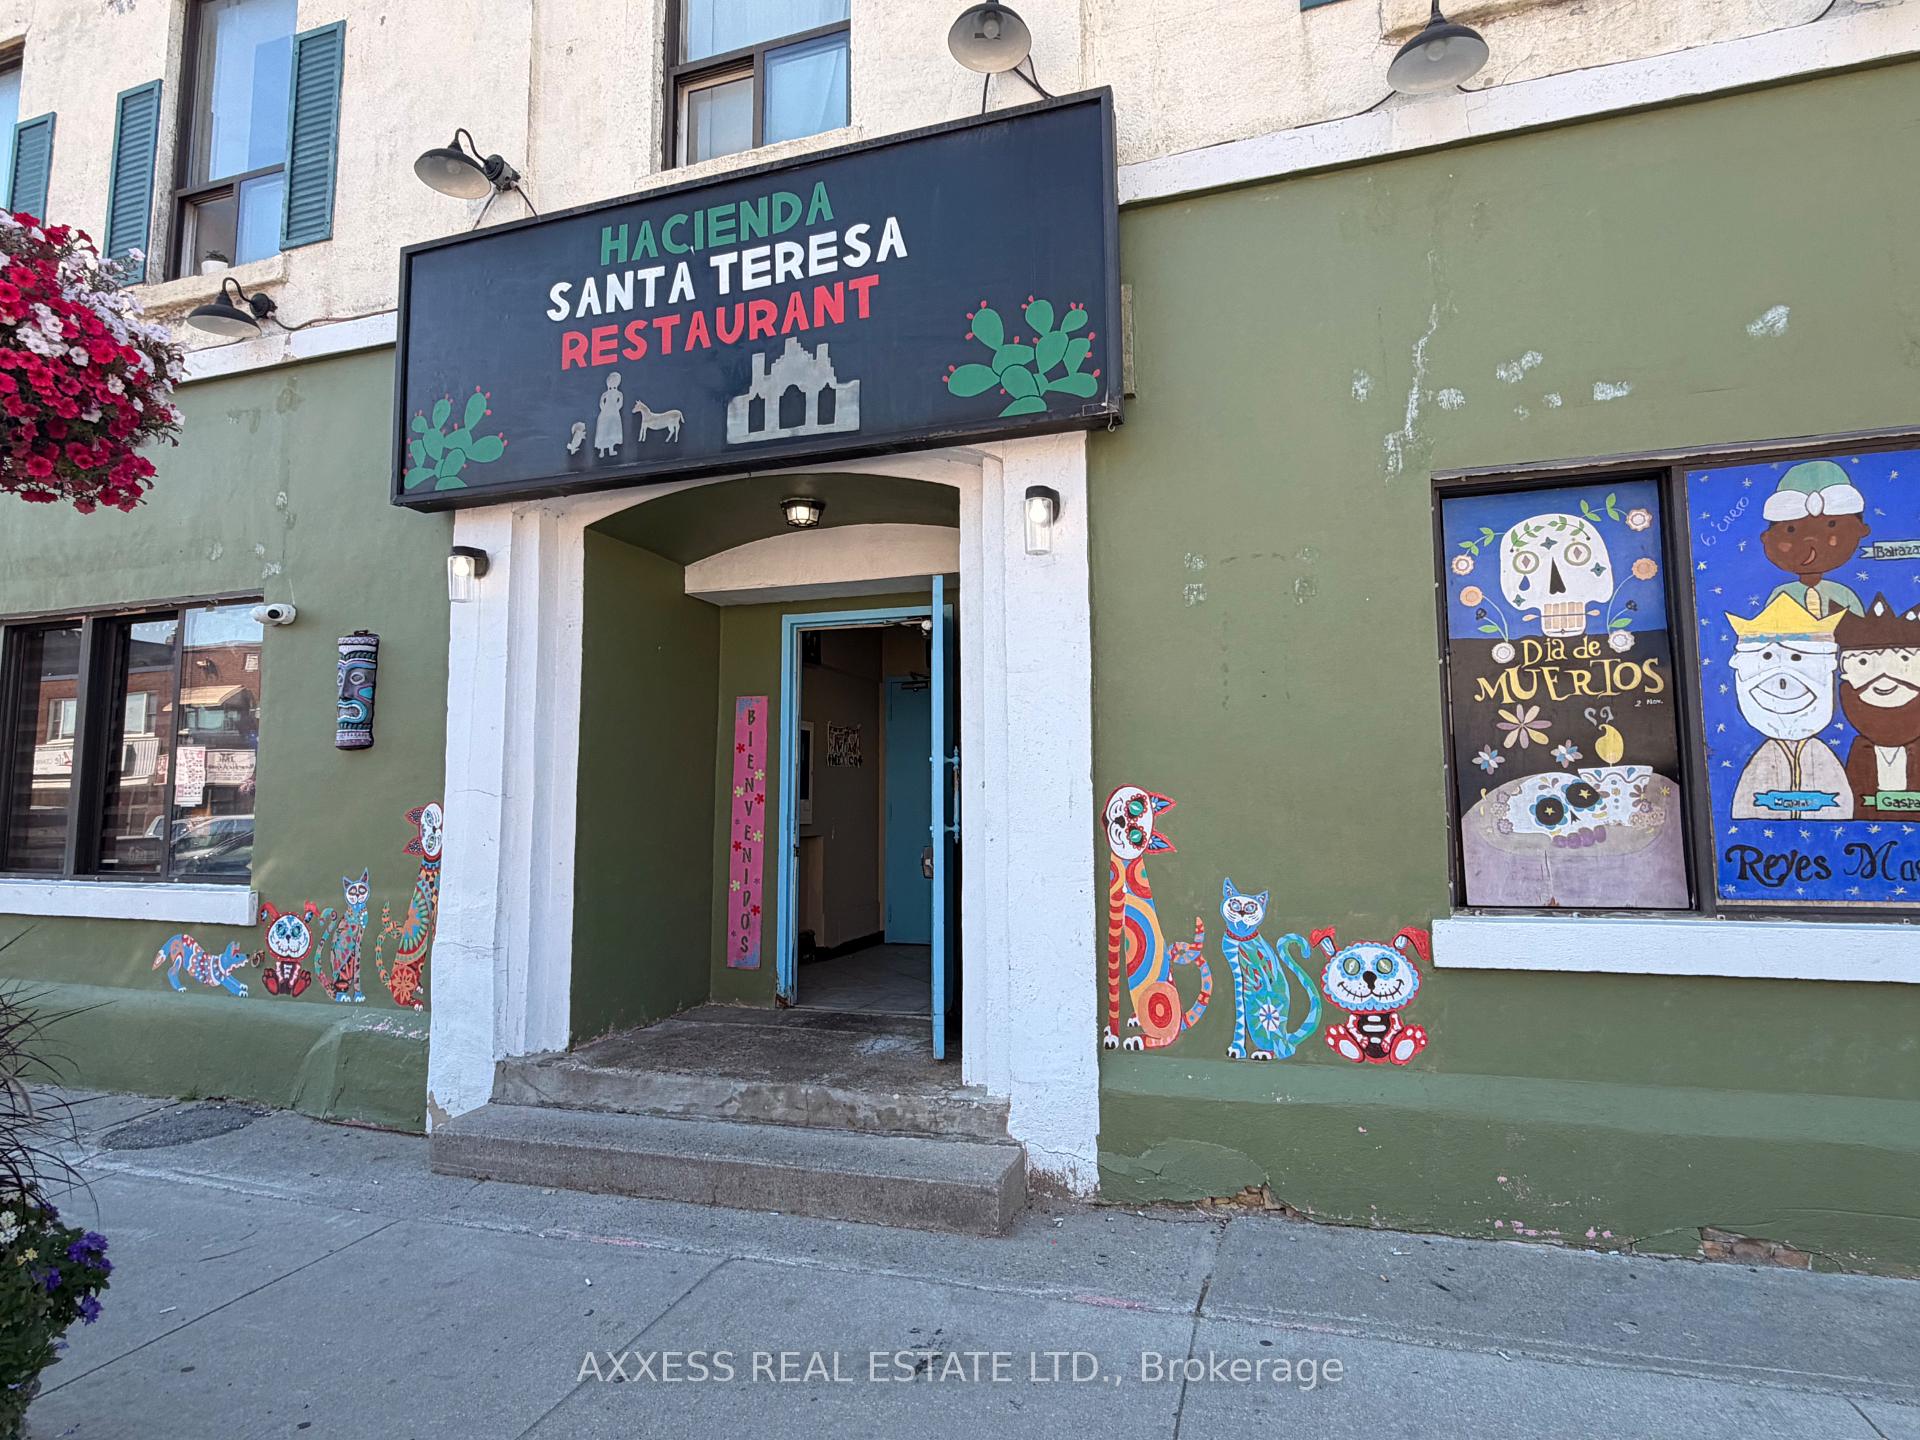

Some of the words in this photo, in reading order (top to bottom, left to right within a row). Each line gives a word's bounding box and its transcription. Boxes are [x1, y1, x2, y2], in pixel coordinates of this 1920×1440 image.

[600, 181, 834, 266] HACIENDA
[546, 261, 696, 322] SANTA
[710, 216, 908, 295] TERESA
[561, 274, 880, 370] RESTAURANT
[1474, 657, 1665, 704] MUERTOS
[1573, 636, 1602, 659] de
[740, 709, 756, 953] BIENVENIDOS
[1725, 844, 1832, 888] Reyes
